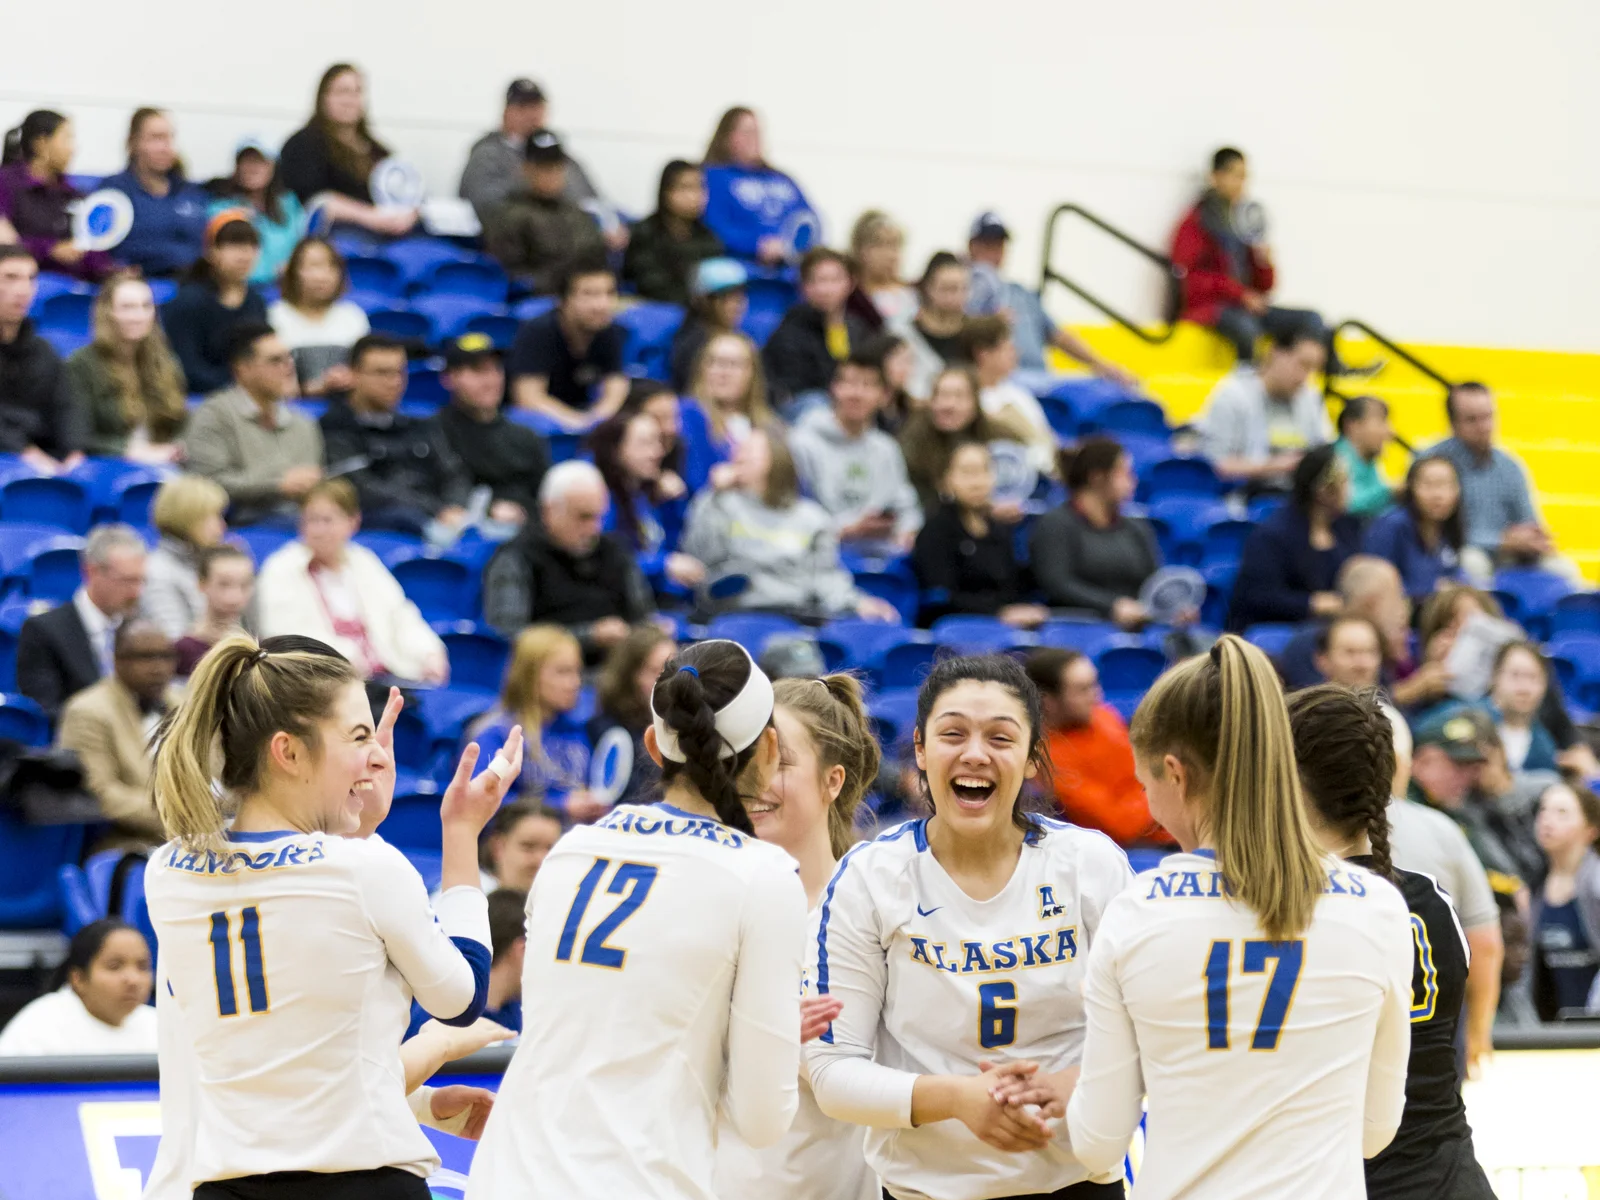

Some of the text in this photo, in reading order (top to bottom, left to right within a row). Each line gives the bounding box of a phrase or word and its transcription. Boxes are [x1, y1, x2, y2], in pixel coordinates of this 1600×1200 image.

[554, 856, 660, 972] 12
[1145, 869, 1368, 900] NANKS
[208, 904, 271, 1018] 11
[908, 925, 1078, 976] ALASKA
[1201, 938, 1307, 1052] 17
[977, 979, 1019, 1050] 6
